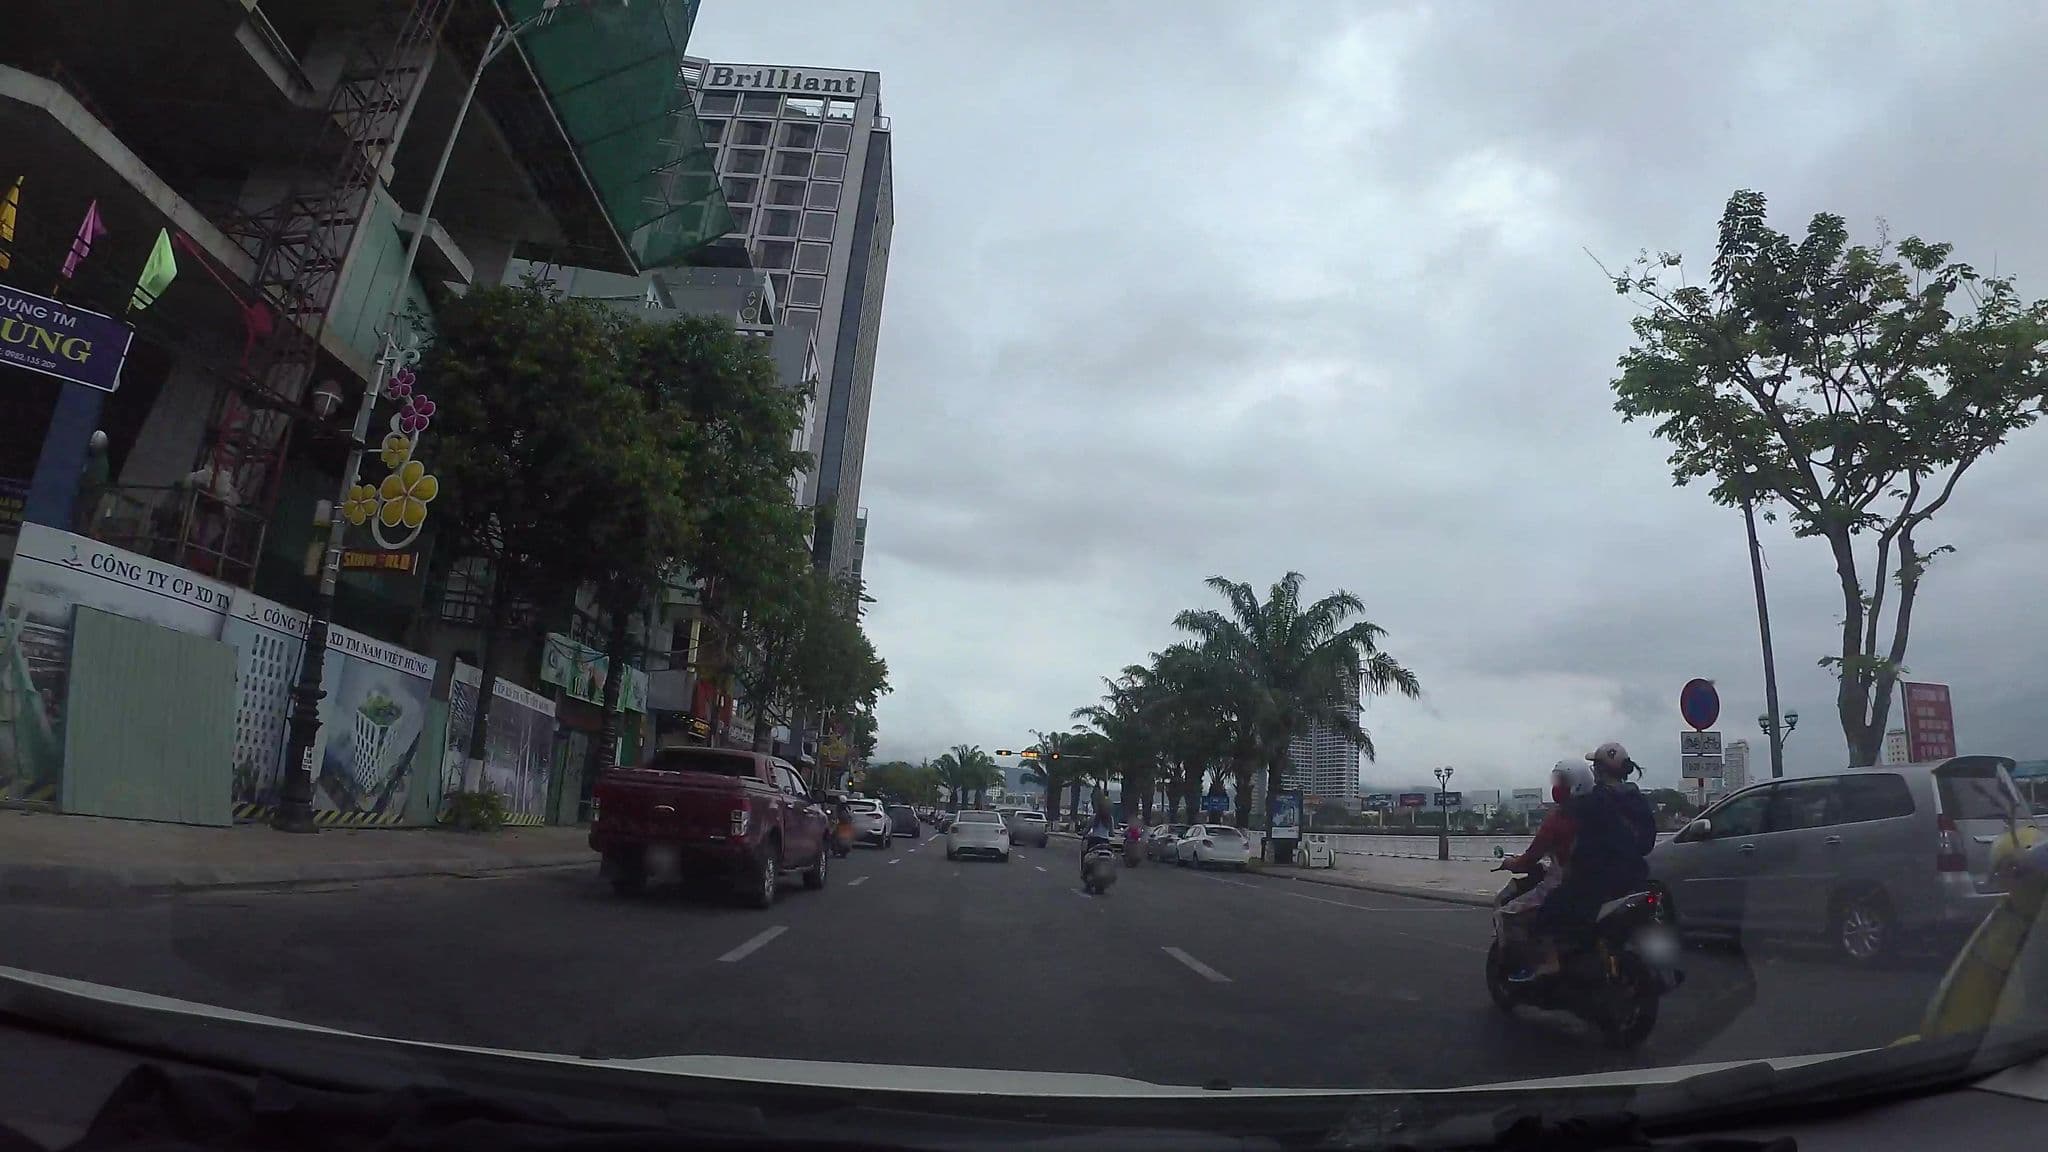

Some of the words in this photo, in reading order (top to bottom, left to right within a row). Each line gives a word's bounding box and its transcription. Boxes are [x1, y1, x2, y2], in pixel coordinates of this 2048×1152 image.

[708, 66, 857, 93] Brilliant
[0, 313, 92, 364] ÙNG
[53, 311, 77, 328] TM
[91, 553, 141, 581] CÔNG
[147, 570, 169, 588] TY
[172, 578, 193, 596] CP
[195, 585, 213, 604] XD
[264, 608, 295, 631] CÔNG
[329, 631, 344, 646] XD
[346, 637, 360, 652] TM
[362, 643, 382, 659] NAM
